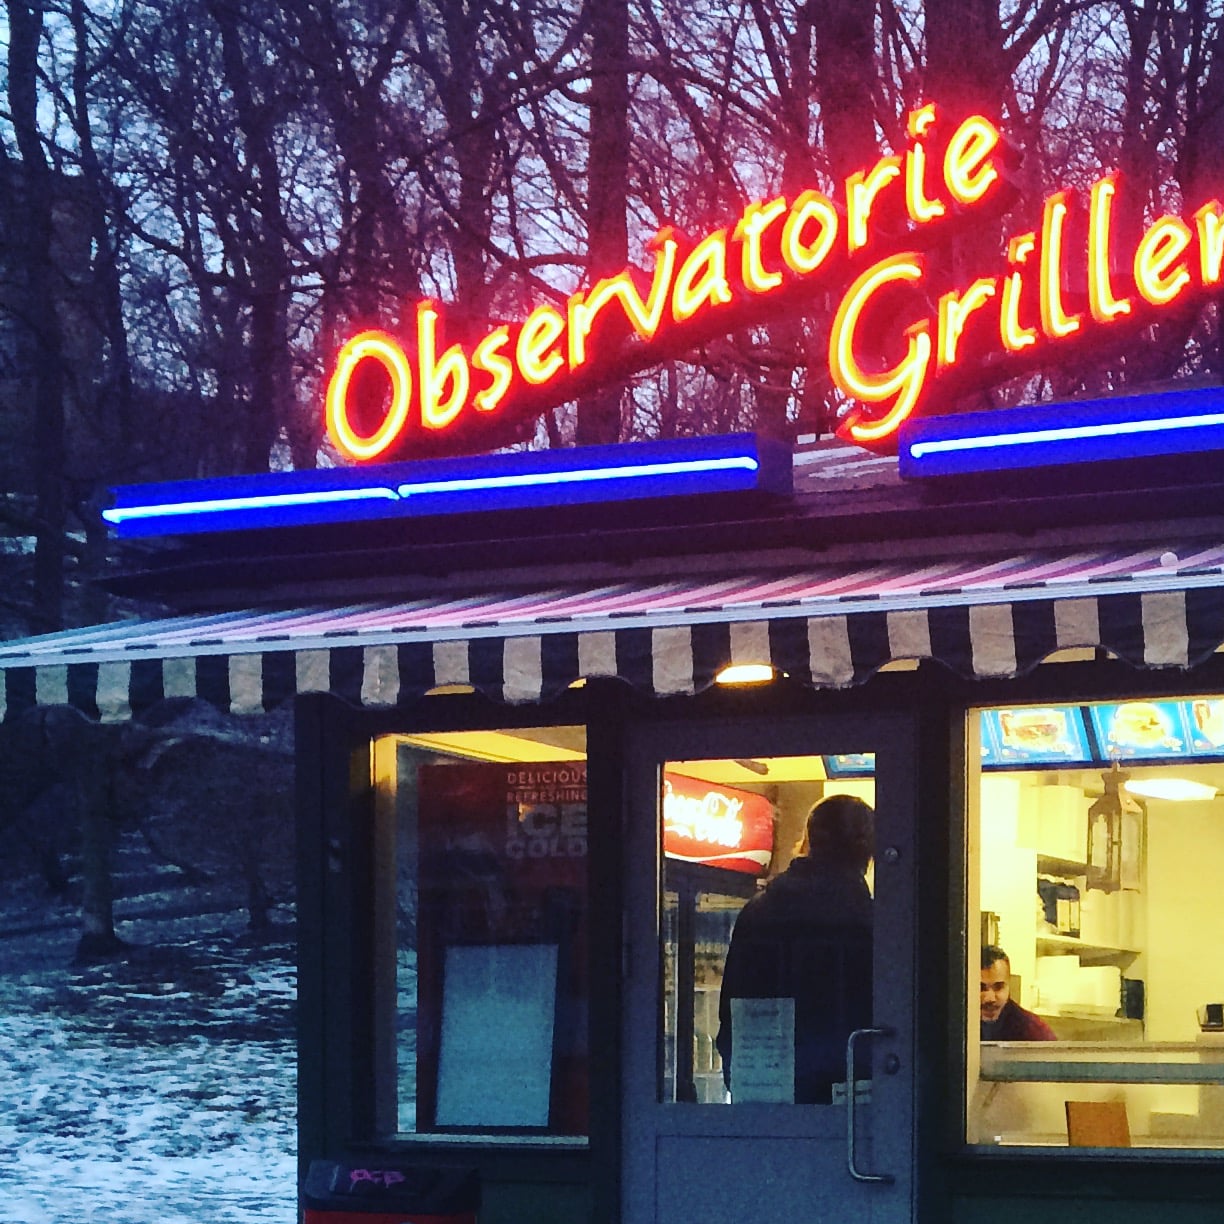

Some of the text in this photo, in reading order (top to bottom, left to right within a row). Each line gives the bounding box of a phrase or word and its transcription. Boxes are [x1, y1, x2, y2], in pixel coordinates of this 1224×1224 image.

[325, 102, 1002, 462] Observatorie
[507, 803, 588, 836] ICE
[506, 837, 588, 859] COLD
